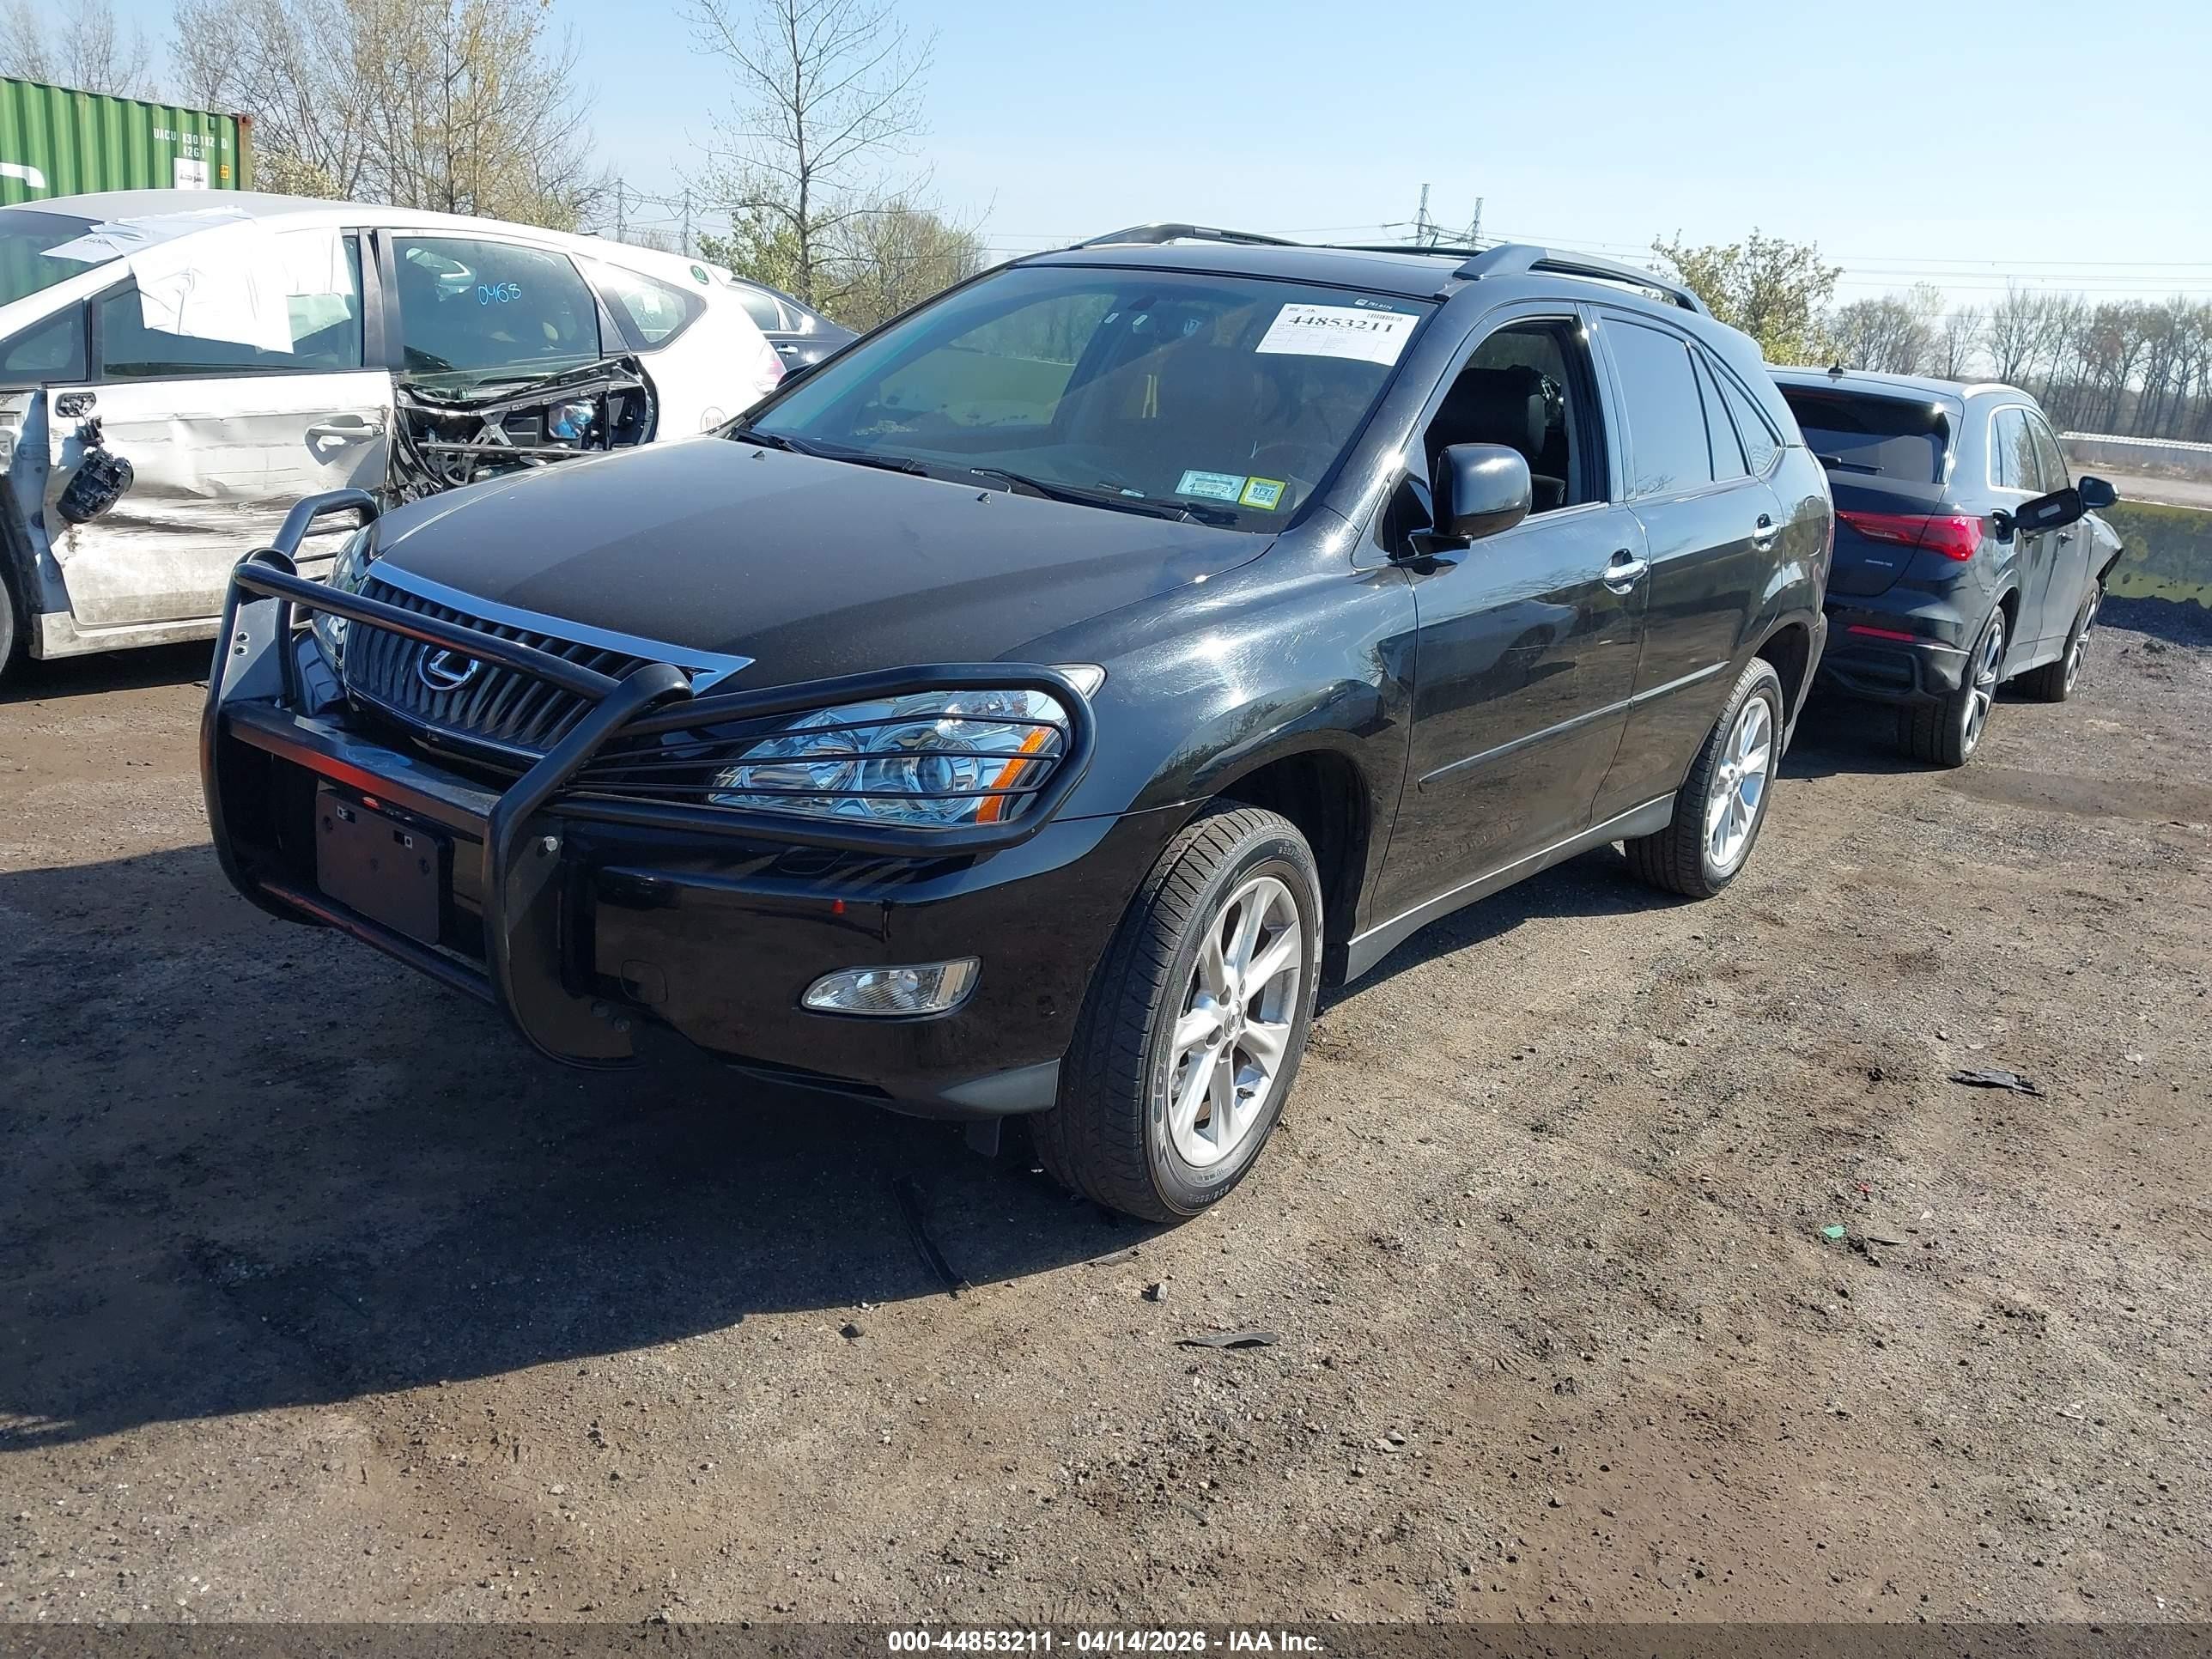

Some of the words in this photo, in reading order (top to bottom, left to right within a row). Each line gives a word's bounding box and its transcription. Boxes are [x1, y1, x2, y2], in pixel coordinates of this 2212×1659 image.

[154, 128, 177, 141] UACU
[183, 146, 205, 159] 42G1
[478, 283, 521, 305] 0468
[1288, 315, 1393, 332] 44853211
